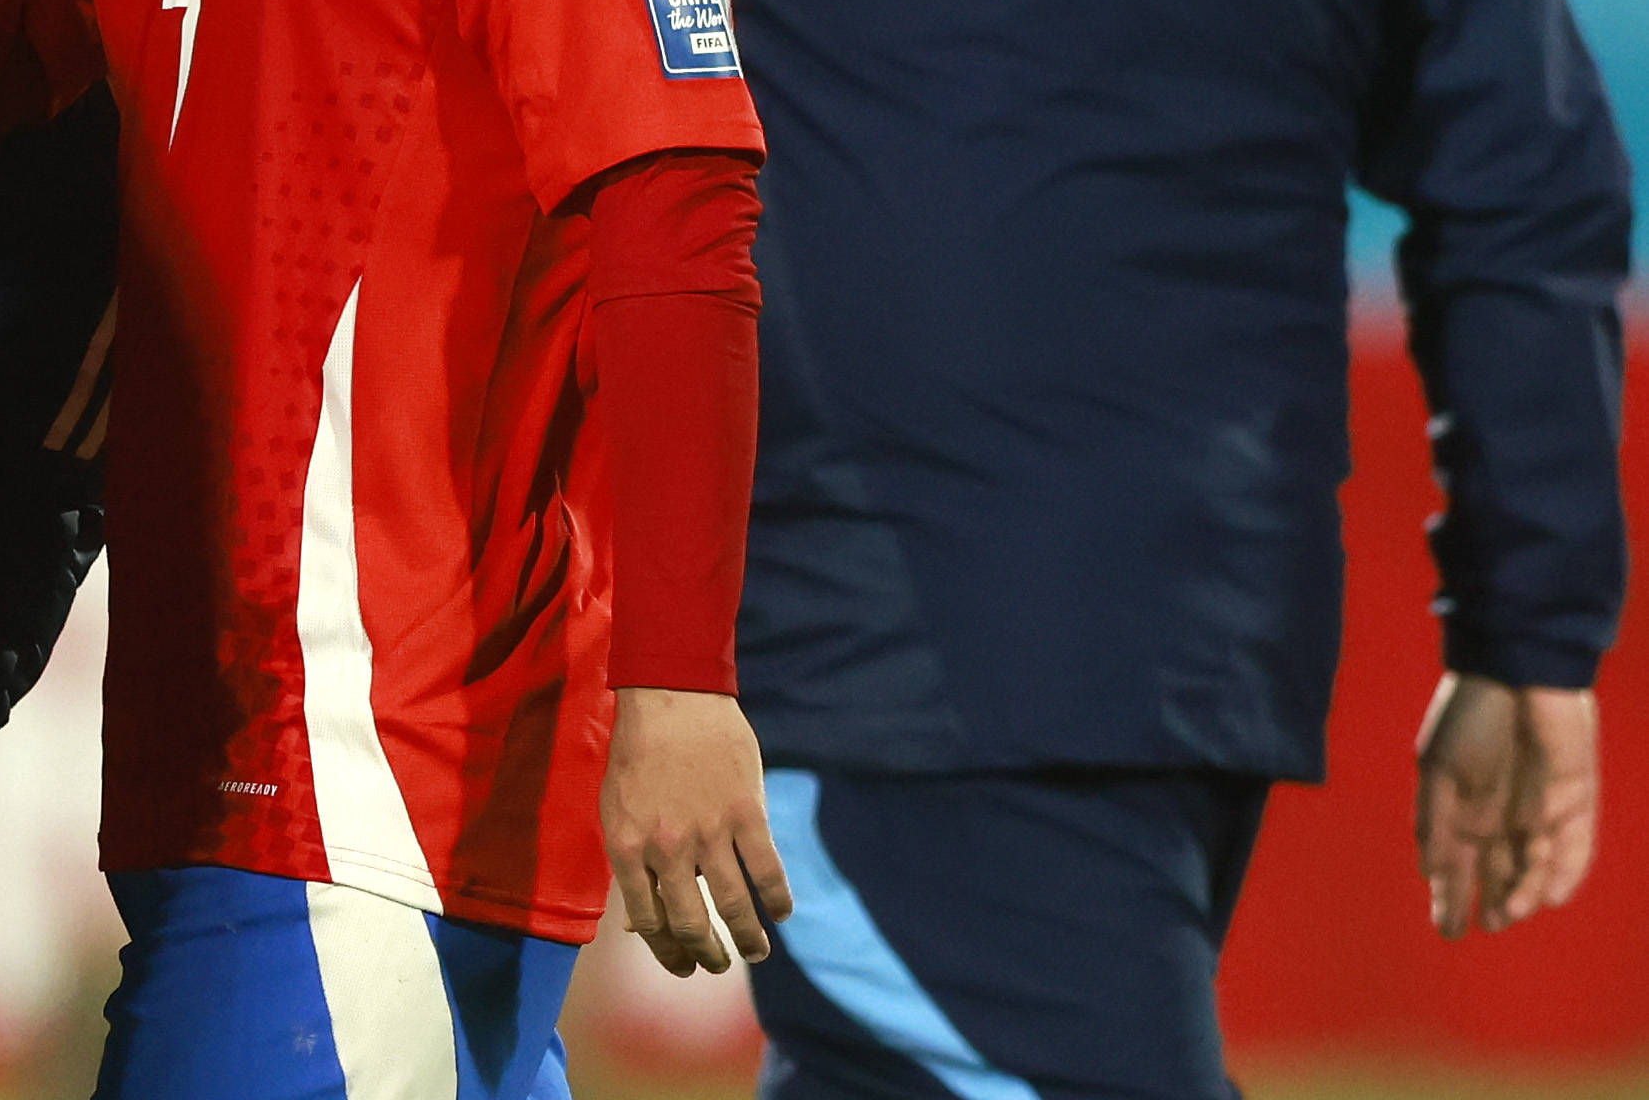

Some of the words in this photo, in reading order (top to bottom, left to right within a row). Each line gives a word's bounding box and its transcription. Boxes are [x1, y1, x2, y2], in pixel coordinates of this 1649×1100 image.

[667, 7, 695, 31] the
[694, 6, 725, 29] Wor
[696, 37, 723, 49] FIFA
[218, 781, 278, 797] AEROREADY
